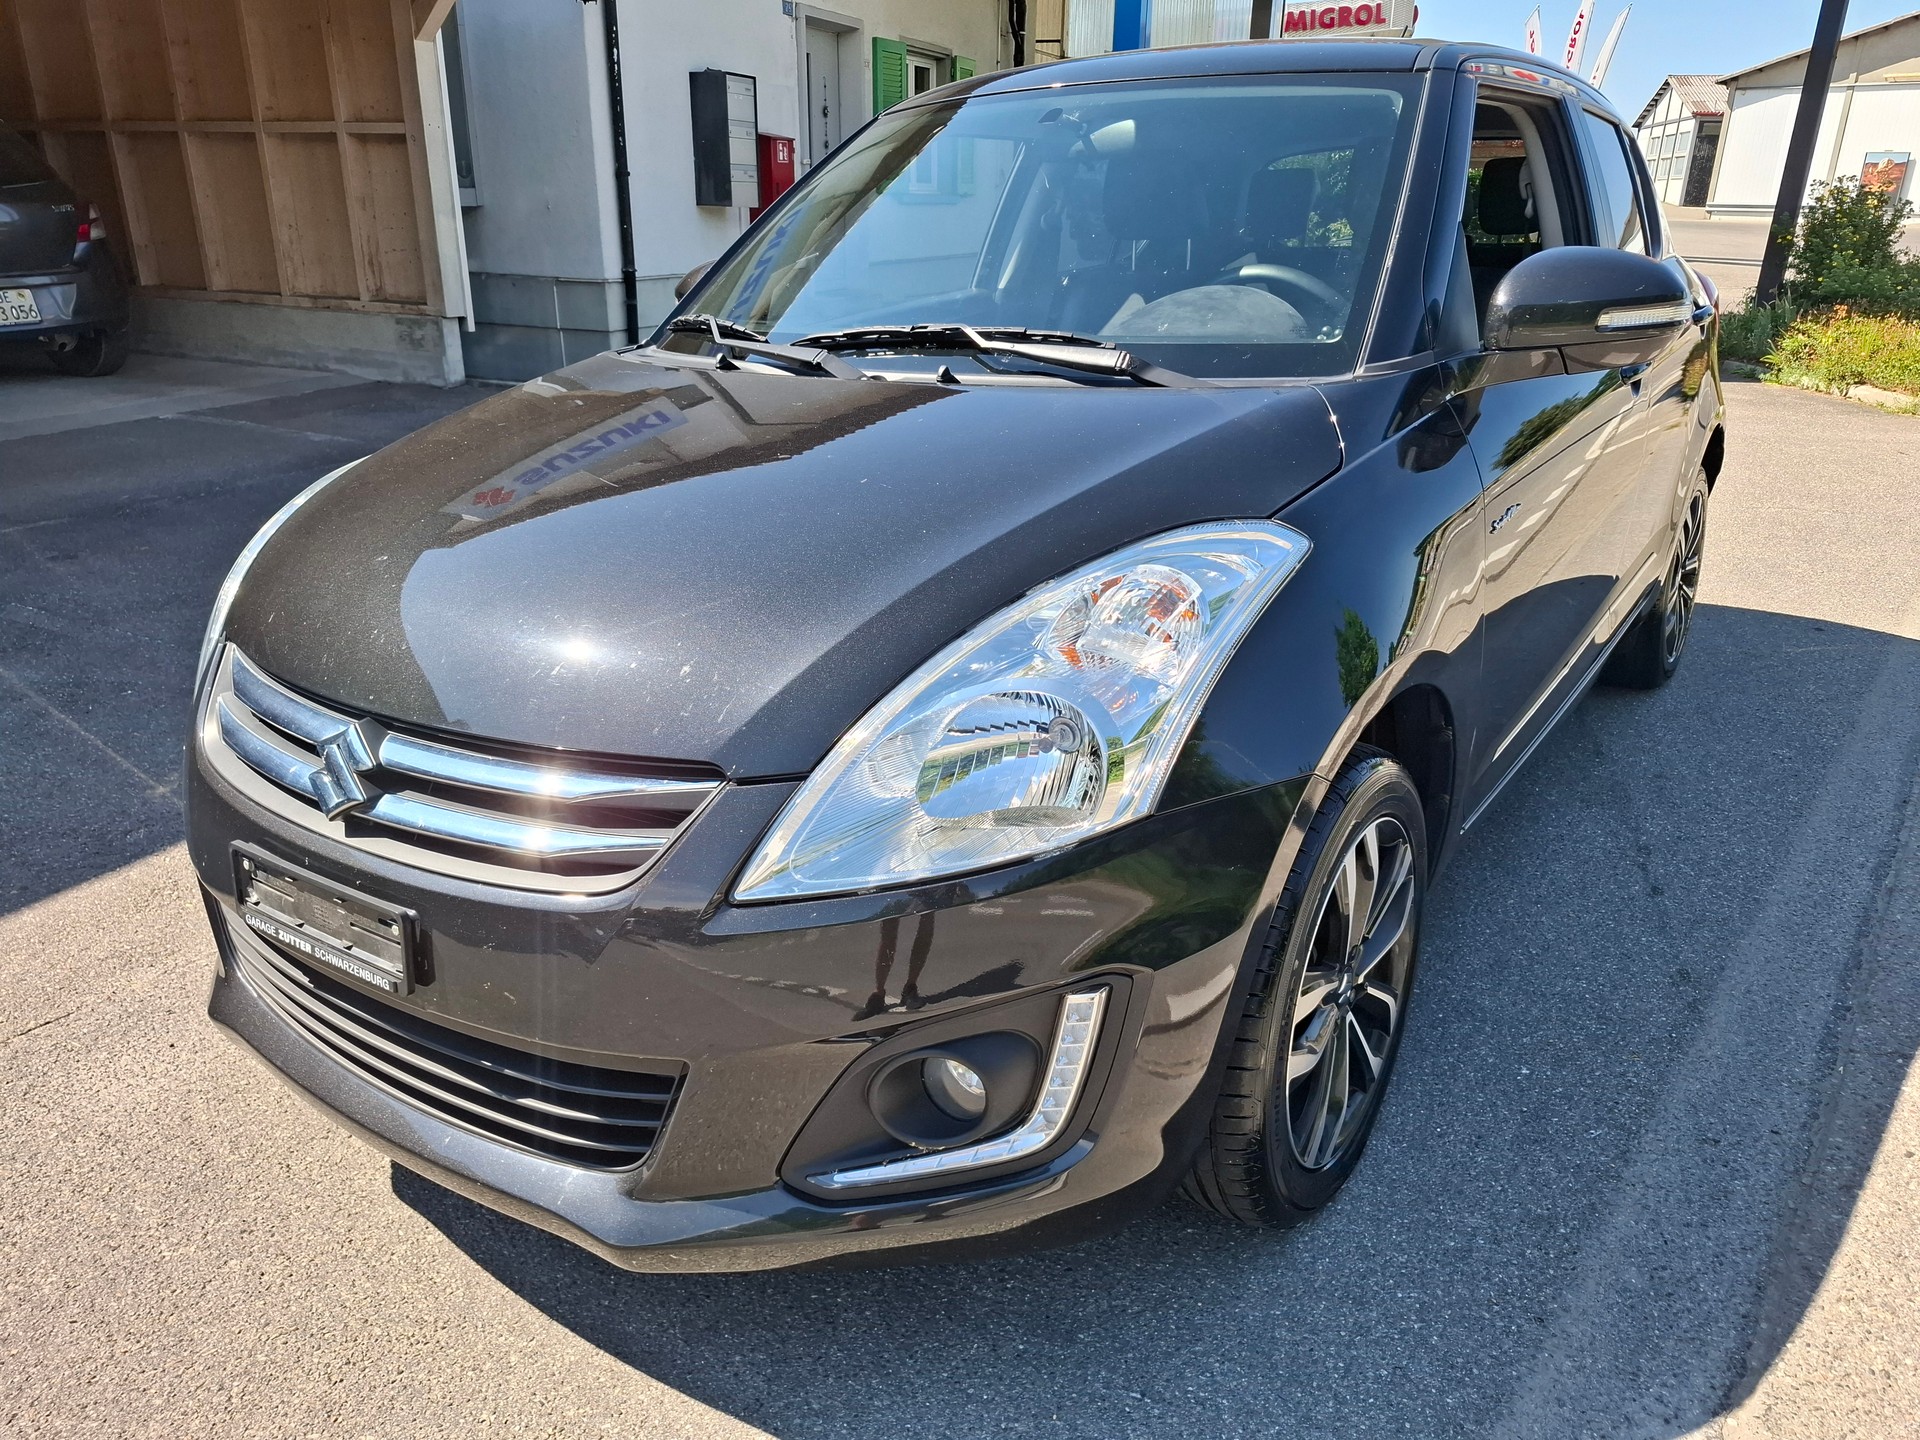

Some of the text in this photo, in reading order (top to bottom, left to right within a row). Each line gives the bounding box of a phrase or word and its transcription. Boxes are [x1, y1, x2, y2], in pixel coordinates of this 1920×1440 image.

[1284, 2, 1386, 33] MIGROL
[245, 914, 391, 991] GARAGE ZUTTER SCHWARZENBURG
